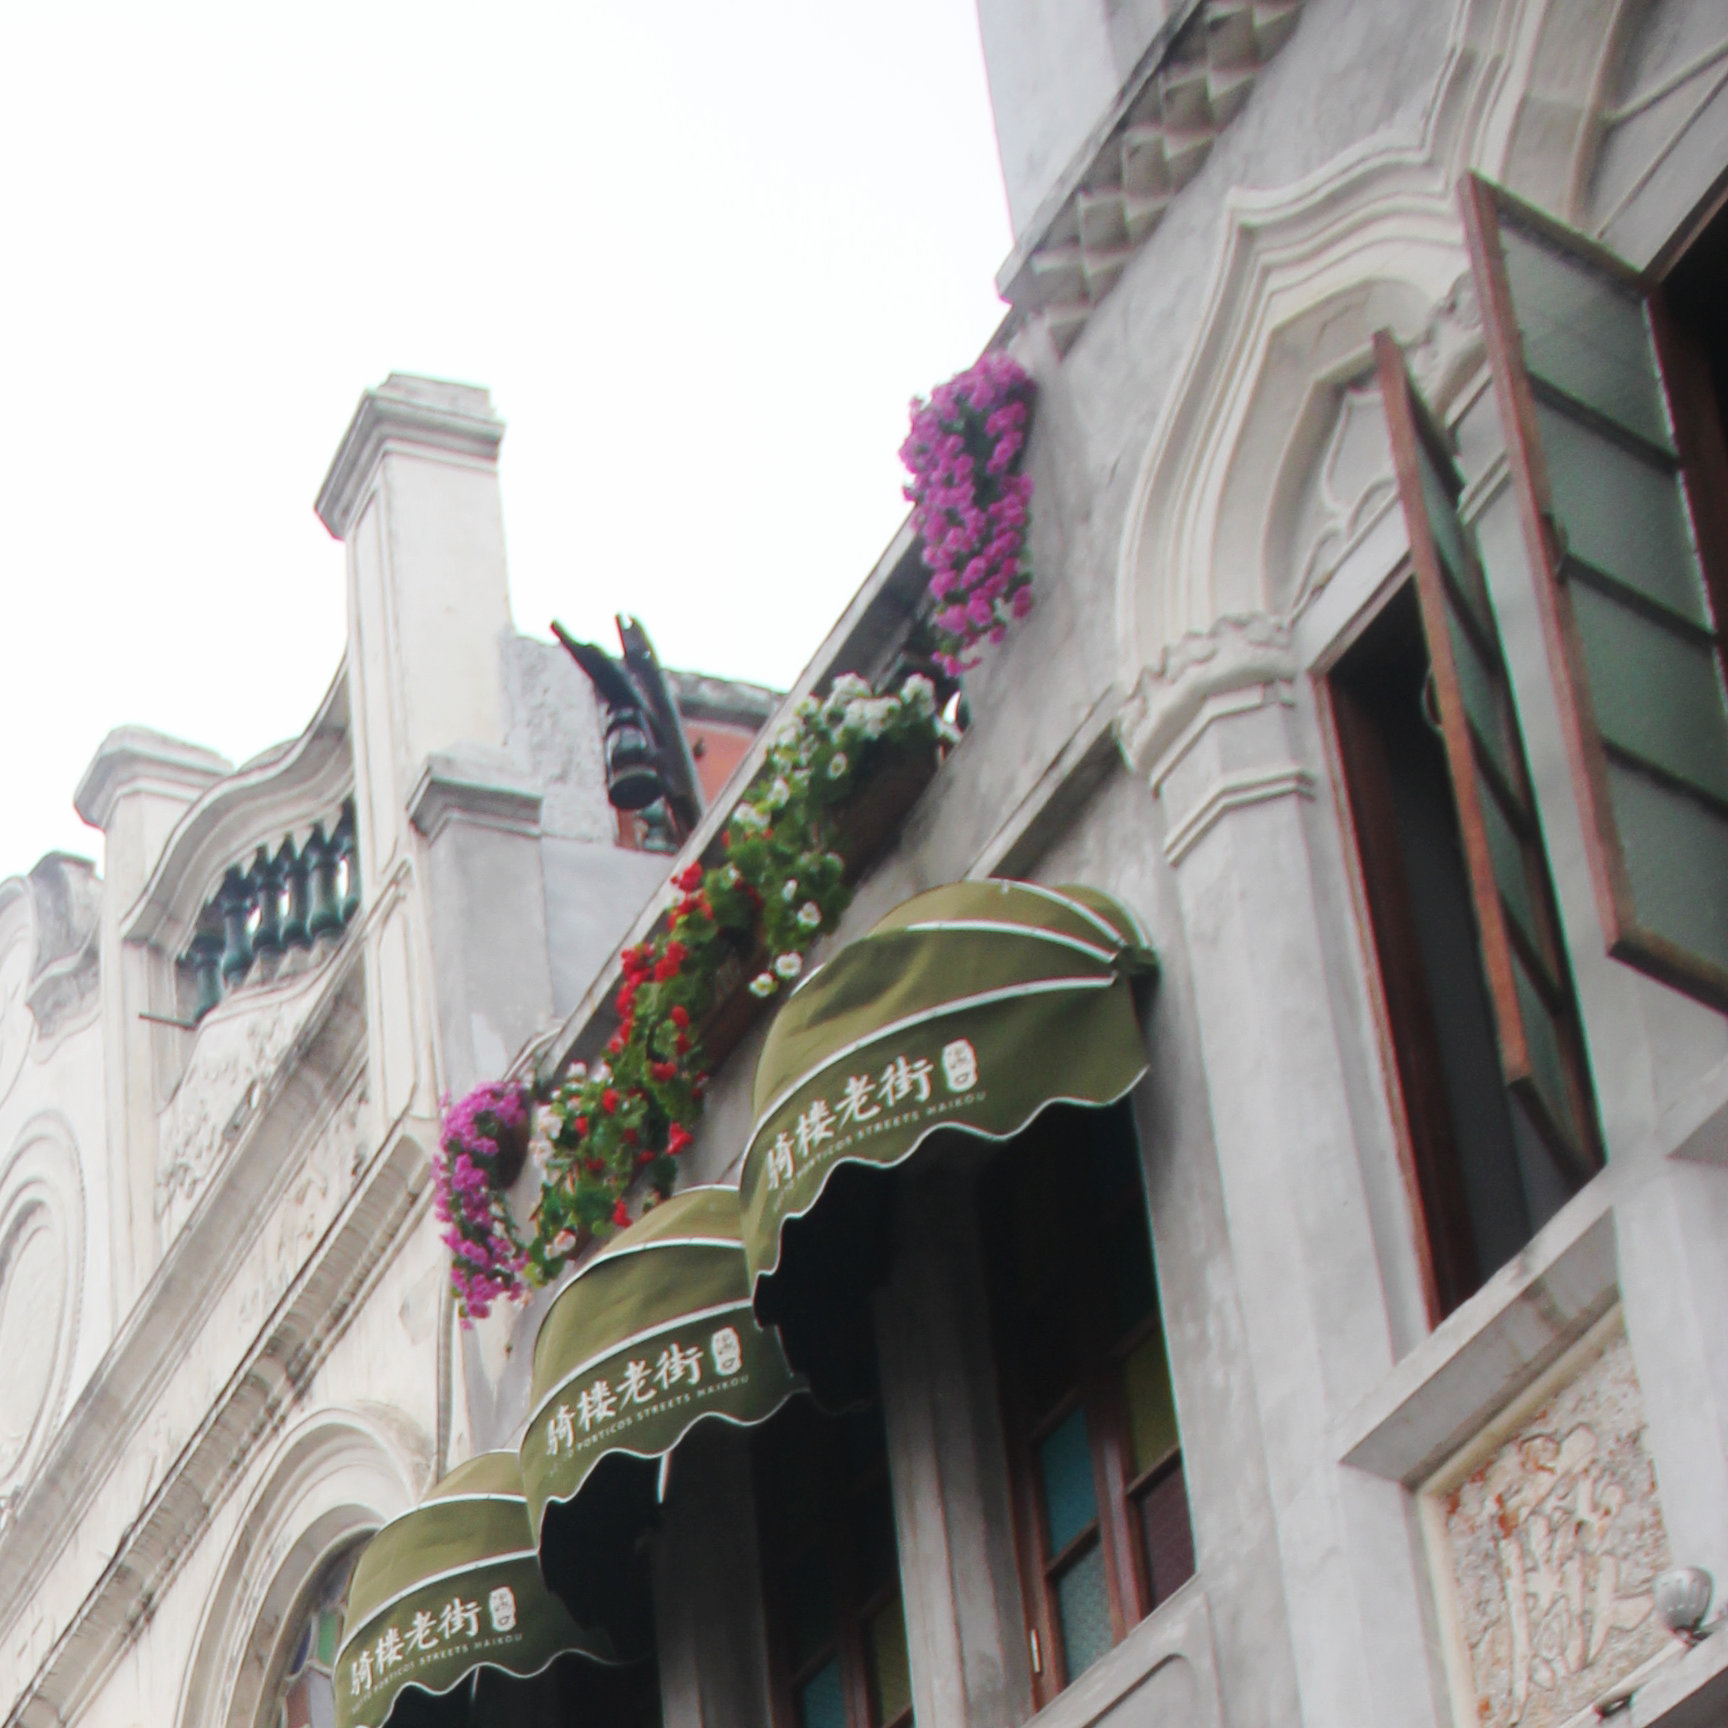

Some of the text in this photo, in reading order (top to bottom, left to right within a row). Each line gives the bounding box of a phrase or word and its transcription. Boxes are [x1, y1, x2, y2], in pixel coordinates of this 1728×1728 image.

[857, 1110, 920, 1141] STREETS
[926, 1091, 987, 1117] HAIKOU
[637, 1393, 690, 1420] STREETS
[696, 1375, 749, 1398] HAIKOU
